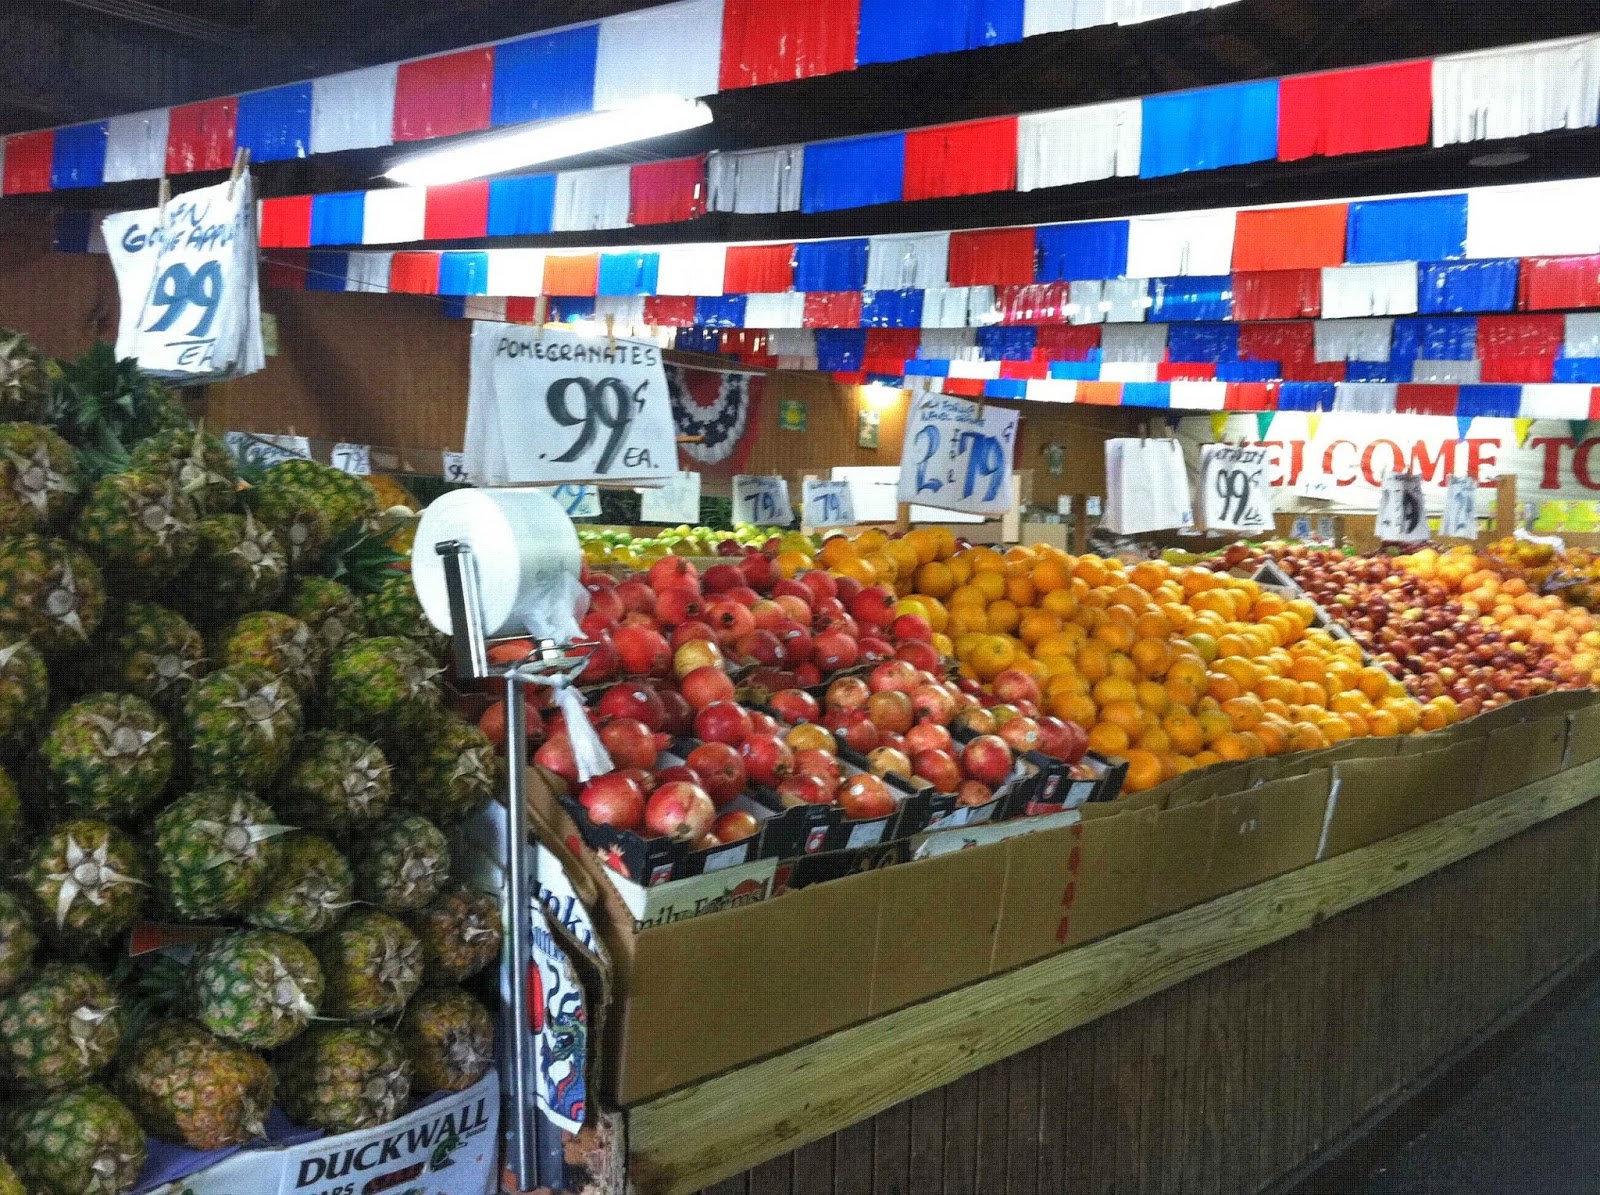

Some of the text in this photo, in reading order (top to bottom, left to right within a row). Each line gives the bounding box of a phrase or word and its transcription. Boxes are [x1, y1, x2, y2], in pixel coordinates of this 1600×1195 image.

[144, 260, 223, 337] 99
[497, 338, 657, 367] POMEGRANATES
[914, 424, 943, 495] 2
[295, 1097, 490, 1189] DUCKWALL
